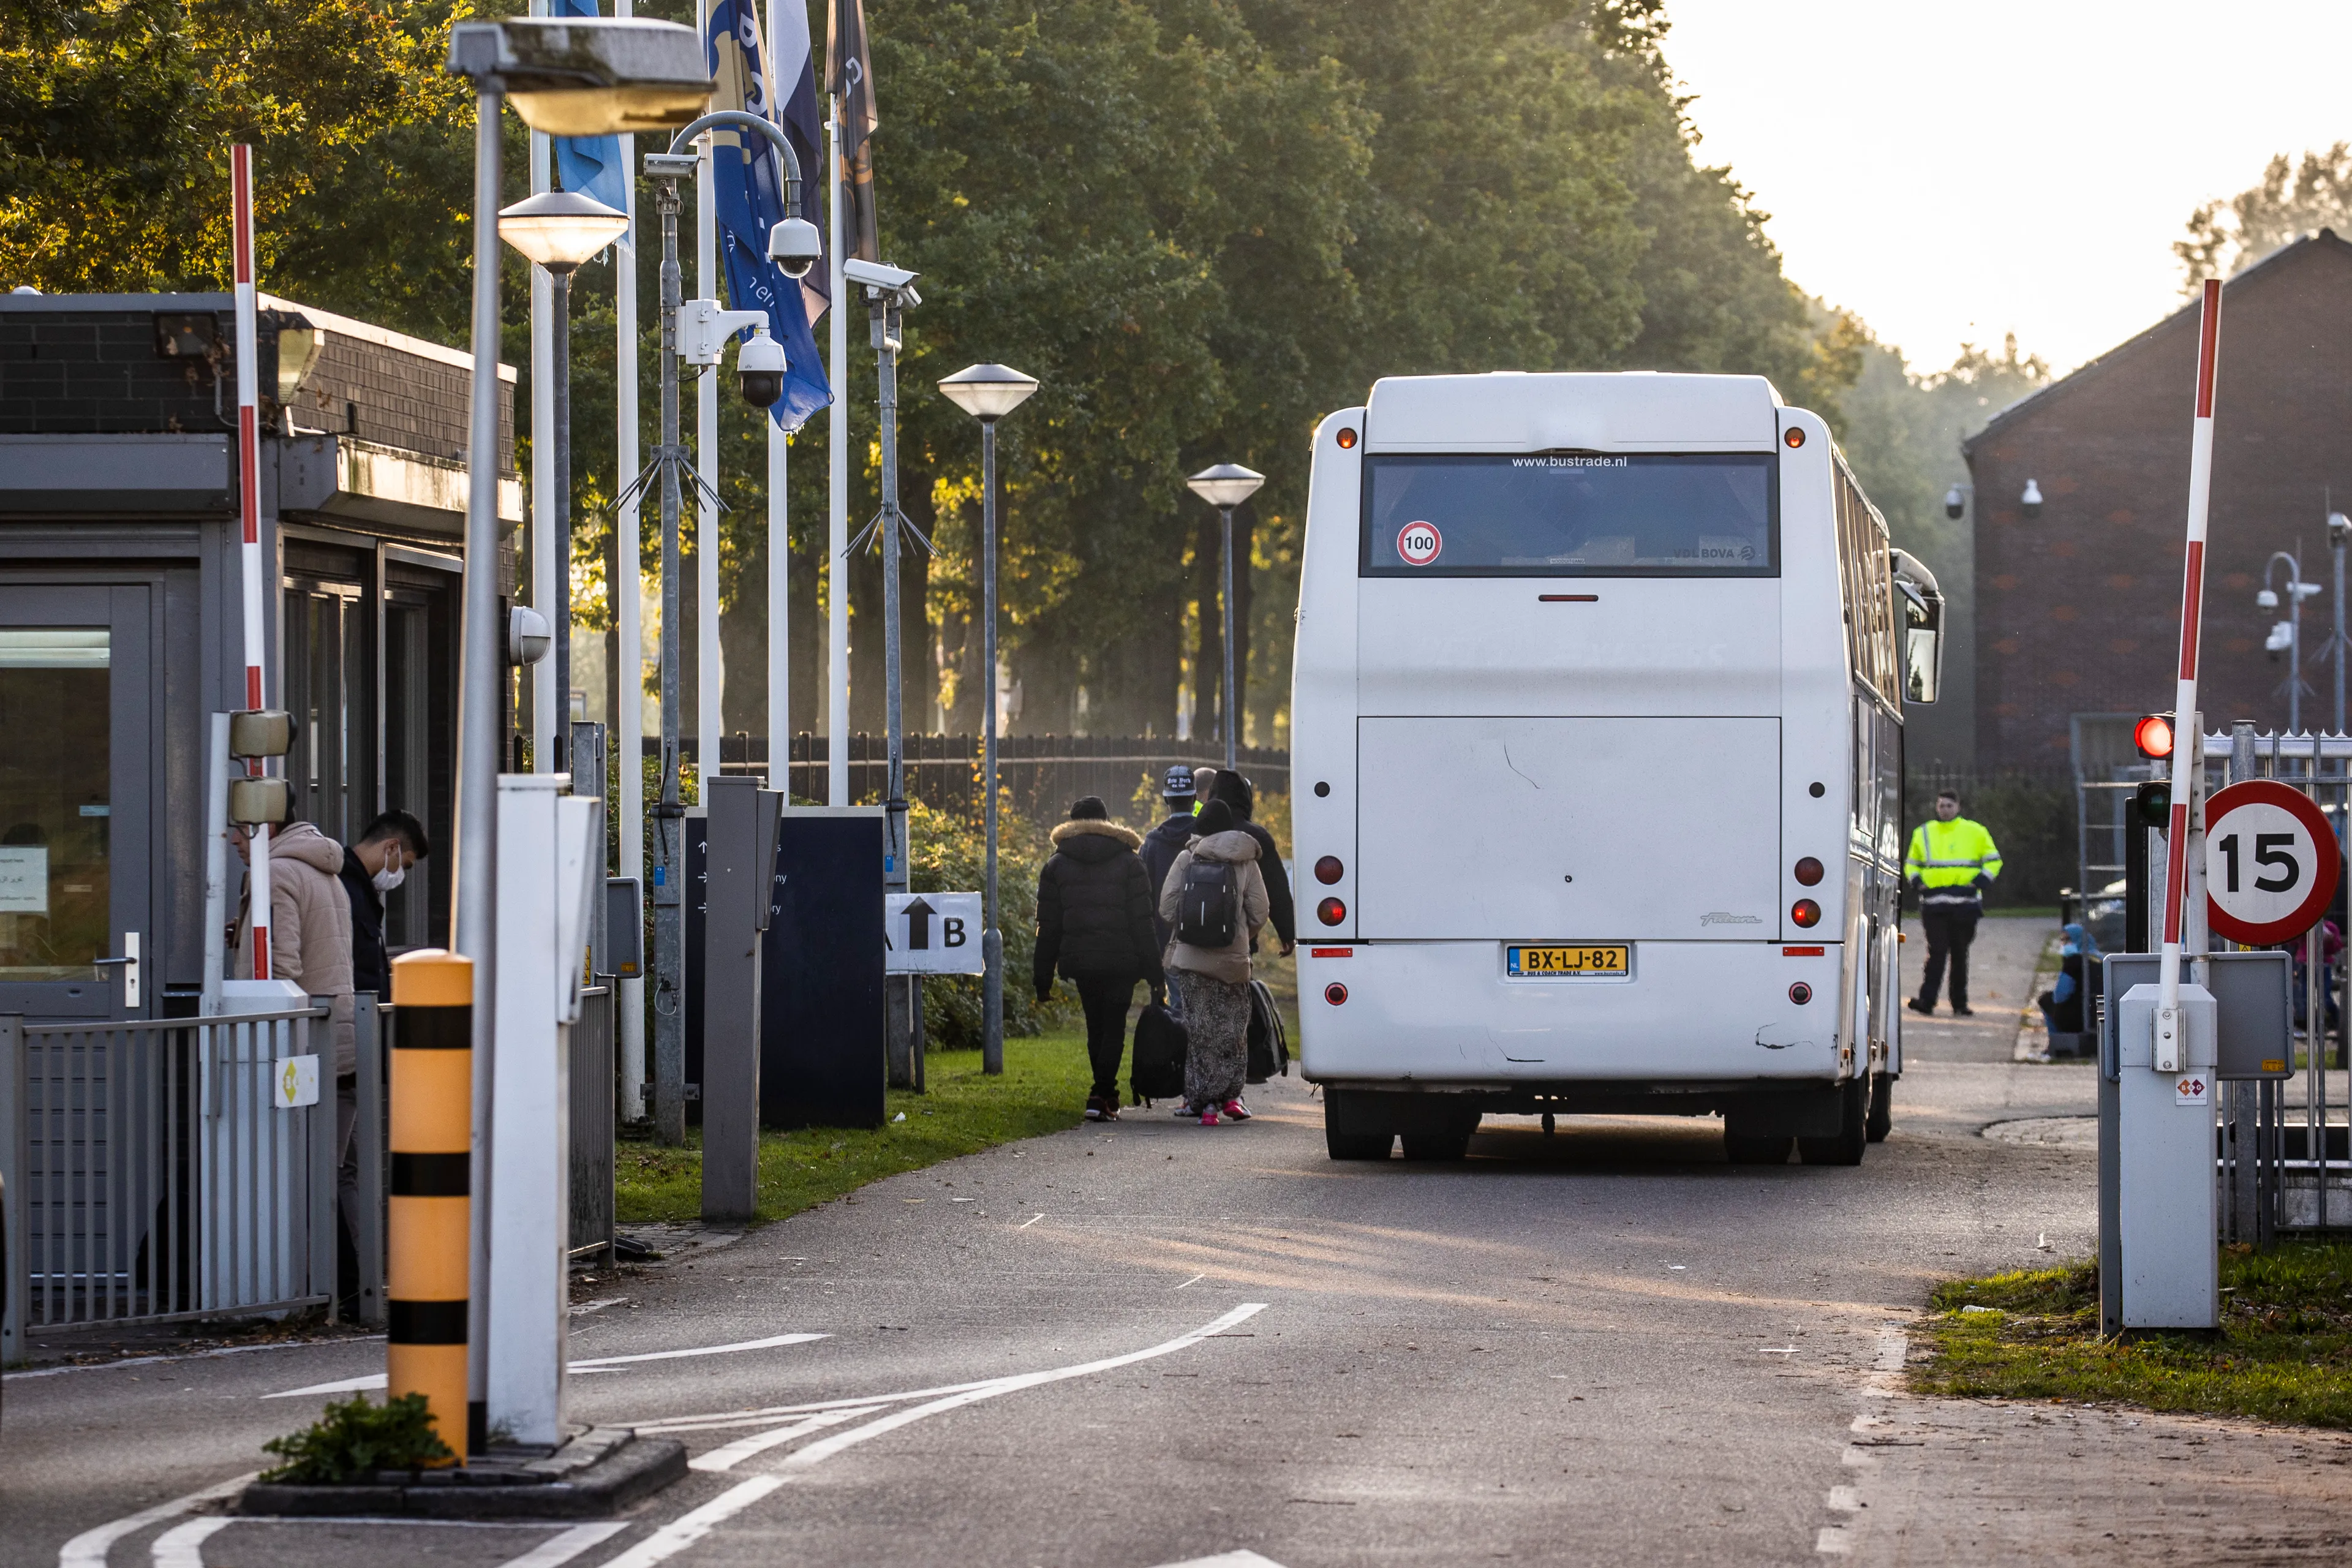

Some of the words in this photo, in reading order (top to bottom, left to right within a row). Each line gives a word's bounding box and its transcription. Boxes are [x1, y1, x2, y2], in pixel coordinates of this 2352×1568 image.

[1512, 456, 1627, 467] www.bustrade.nl
[1405, 536, 1434, 550] 100
[1702, 549, 1734, 558] BOVA
[2219, 834, 2299, 892] 15
[944, 918, 966, 948] B
[1528, 951, 1617, 969] BX-LJ-82
